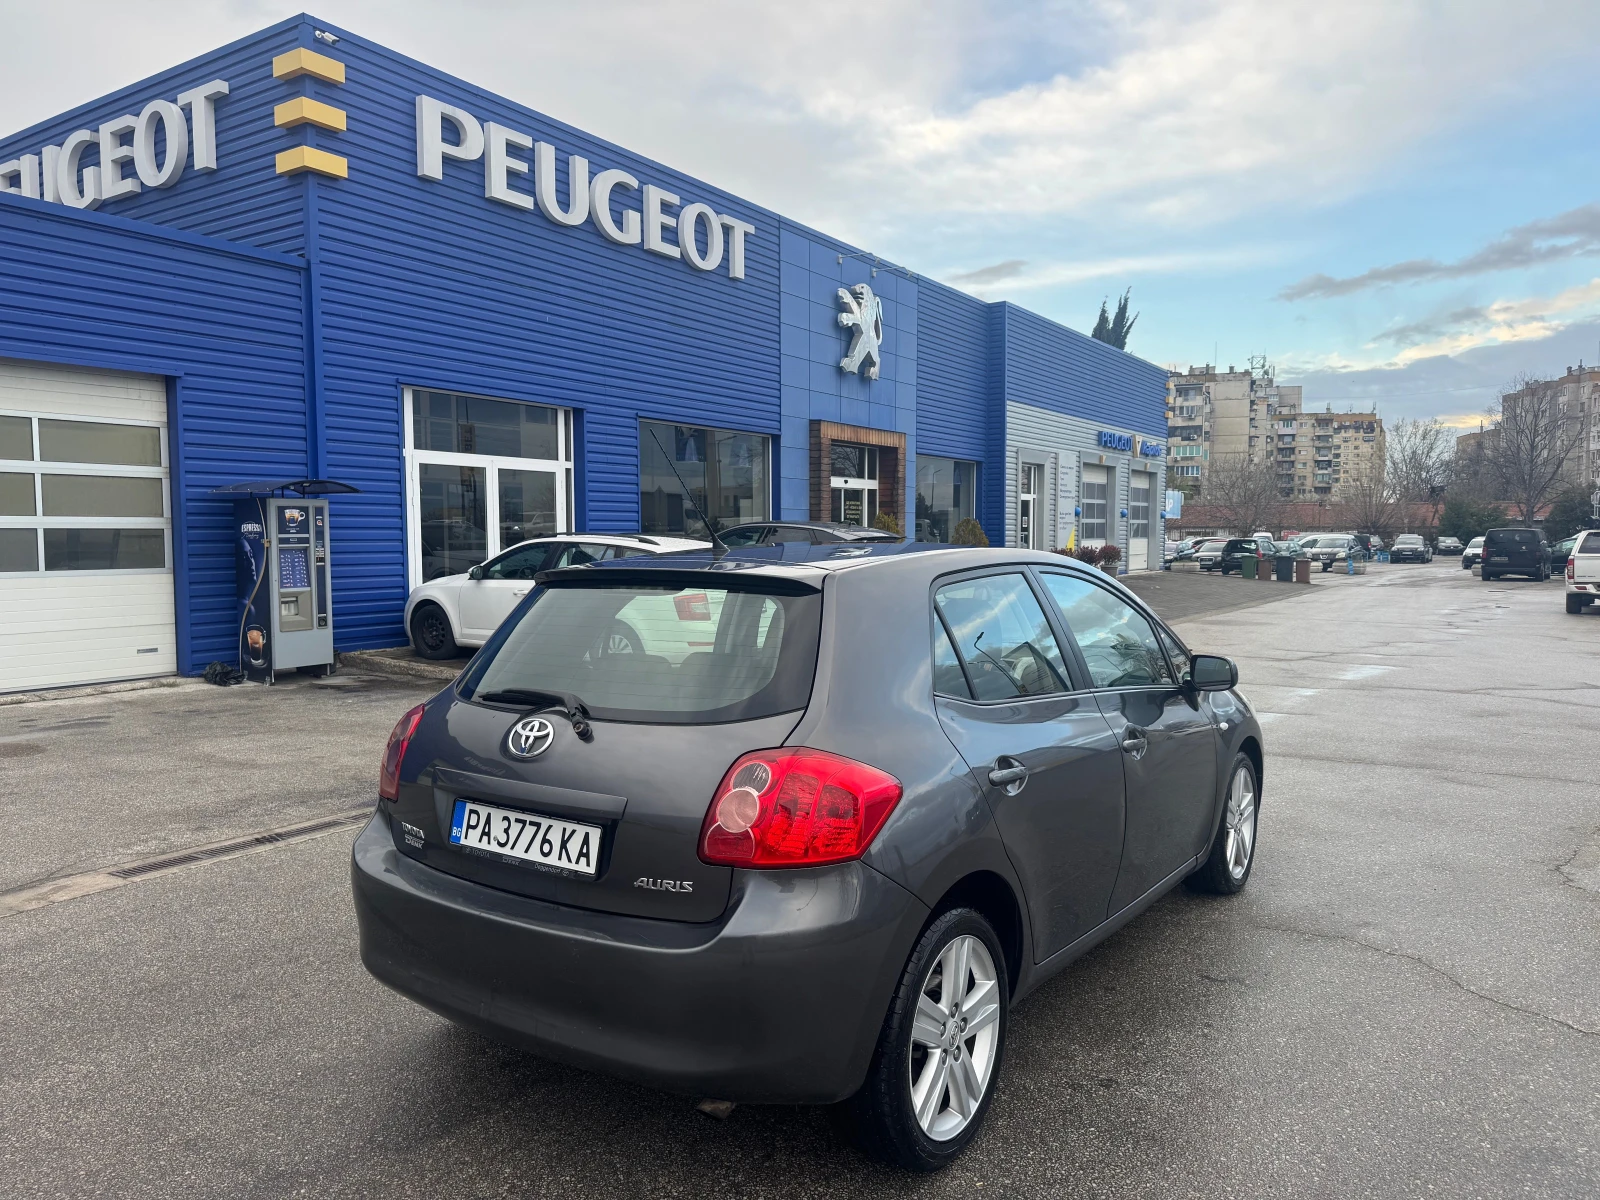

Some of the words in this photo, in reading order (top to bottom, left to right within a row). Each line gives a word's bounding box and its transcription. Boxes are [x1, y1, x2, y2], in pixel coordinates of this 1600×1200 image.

[416, 94, 755, 280] PEUGEOT
[1099, 431, 1133, 451] PEUGEOT
[241, 523, 262, 532] ESPRESSO
[401, 821, 425, 839] TOYOTA
[452, 826, 462, 838] BG
[472, 848, 490, 858] TOYOTA
[633, 877, 694, 892] AURIS
